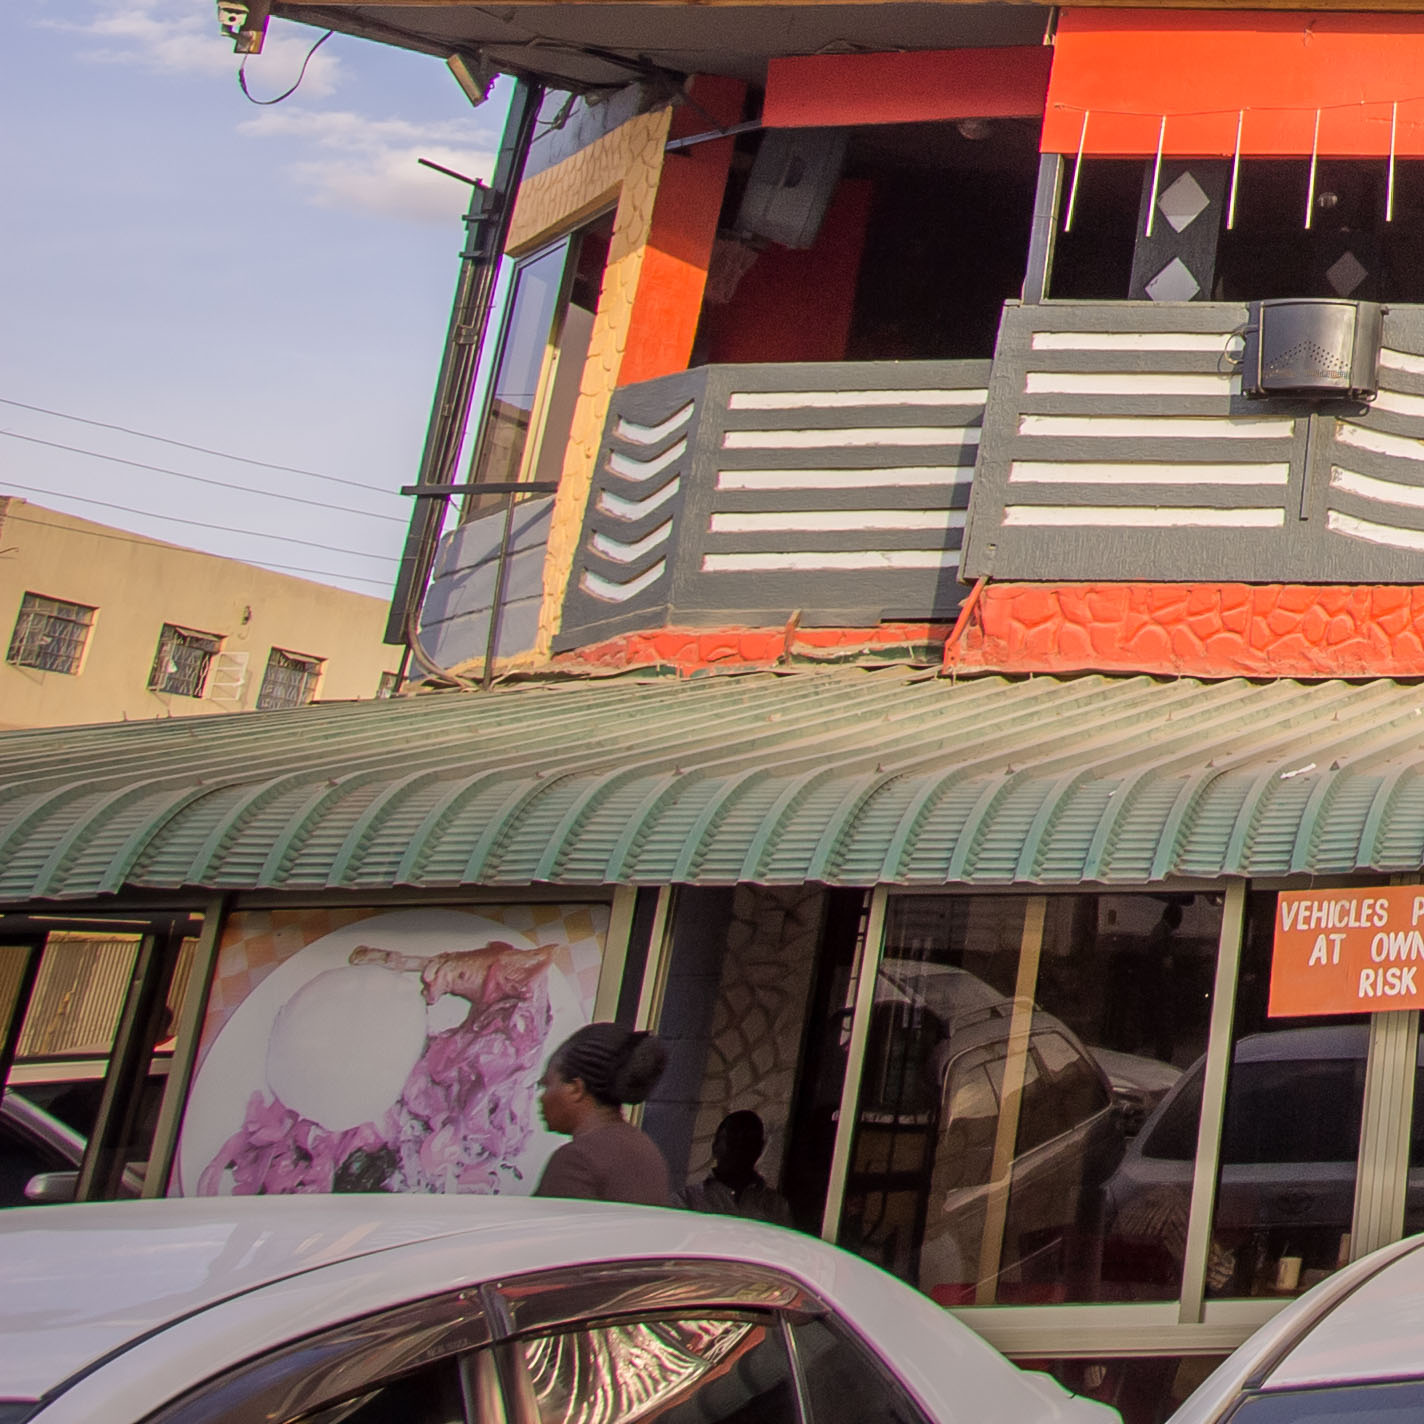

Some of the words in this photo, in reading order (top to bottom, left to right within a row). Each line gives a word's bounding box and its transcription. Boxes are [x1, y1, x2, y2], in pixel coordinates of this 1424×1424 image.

[1281, 897, 1389, 932] VEHICLES
[1308, 932, 1347, 966] AT
[1358, 966, 1417, 998] RISK
